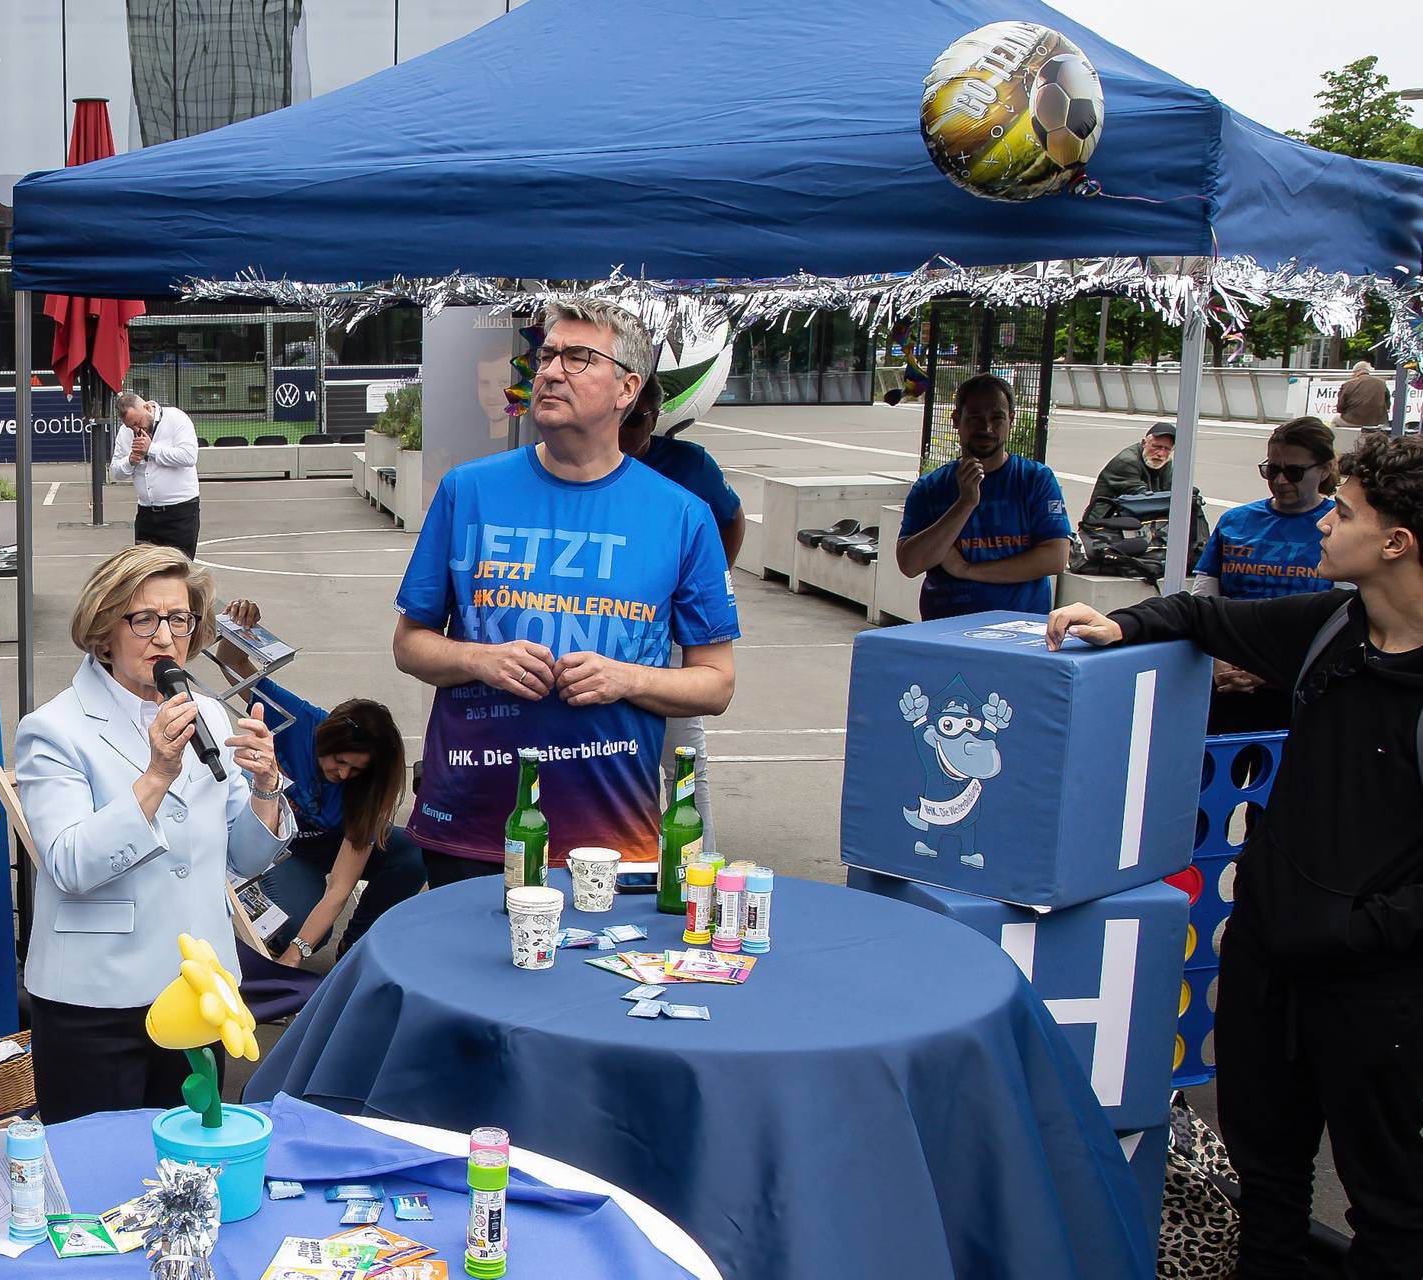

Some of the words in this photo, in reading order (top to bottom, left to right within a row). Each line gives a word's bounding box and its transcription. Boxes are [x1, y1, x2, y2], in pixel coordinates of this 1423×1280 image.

[955, 78, 998, 119] GO
[449, 523, 627, 580] JETZT
[473, 560, 536, 581] JETZT
[473, 585, 657, 623] #KÖNNENLERNEN
[465, 706, 487, 721] aus
[490, 703, 521, 719] uns
[448, 749, 479, 767] IHK.
[483, 749, 513, 767] Die
[517, 738, 639, 762] eiterbildung.
[421, 802, 453, 823] Kempa
